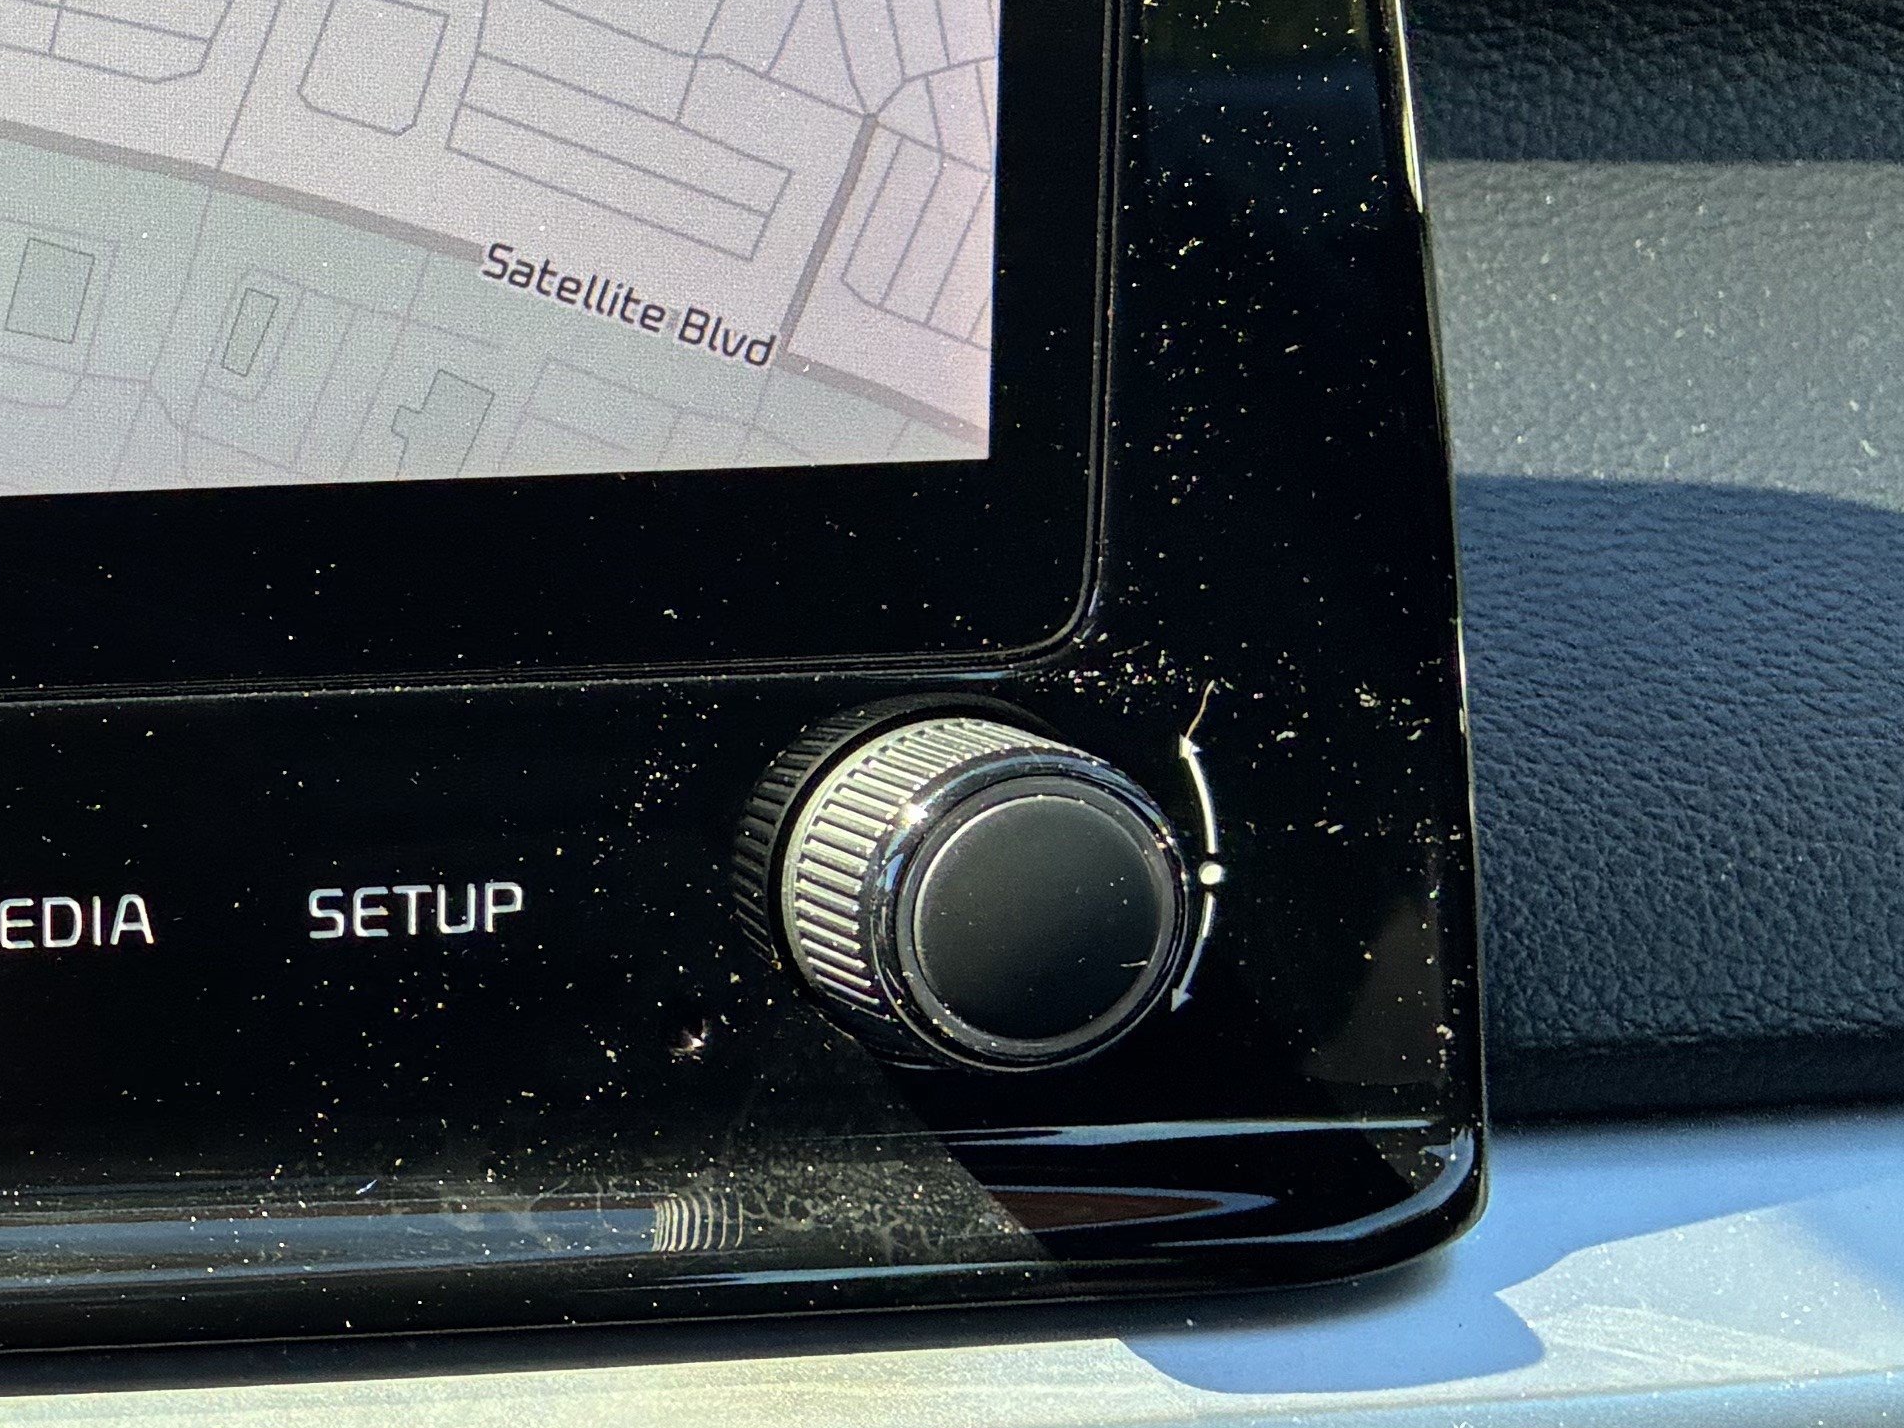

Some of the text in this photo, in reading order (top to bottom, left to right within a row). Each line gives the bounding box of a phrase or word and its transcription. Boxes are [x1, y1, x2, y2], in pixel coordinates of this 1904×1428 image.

[481, 241, 778, 368] Satellite Blvd
[307, 877, 524, 941] SETUP
